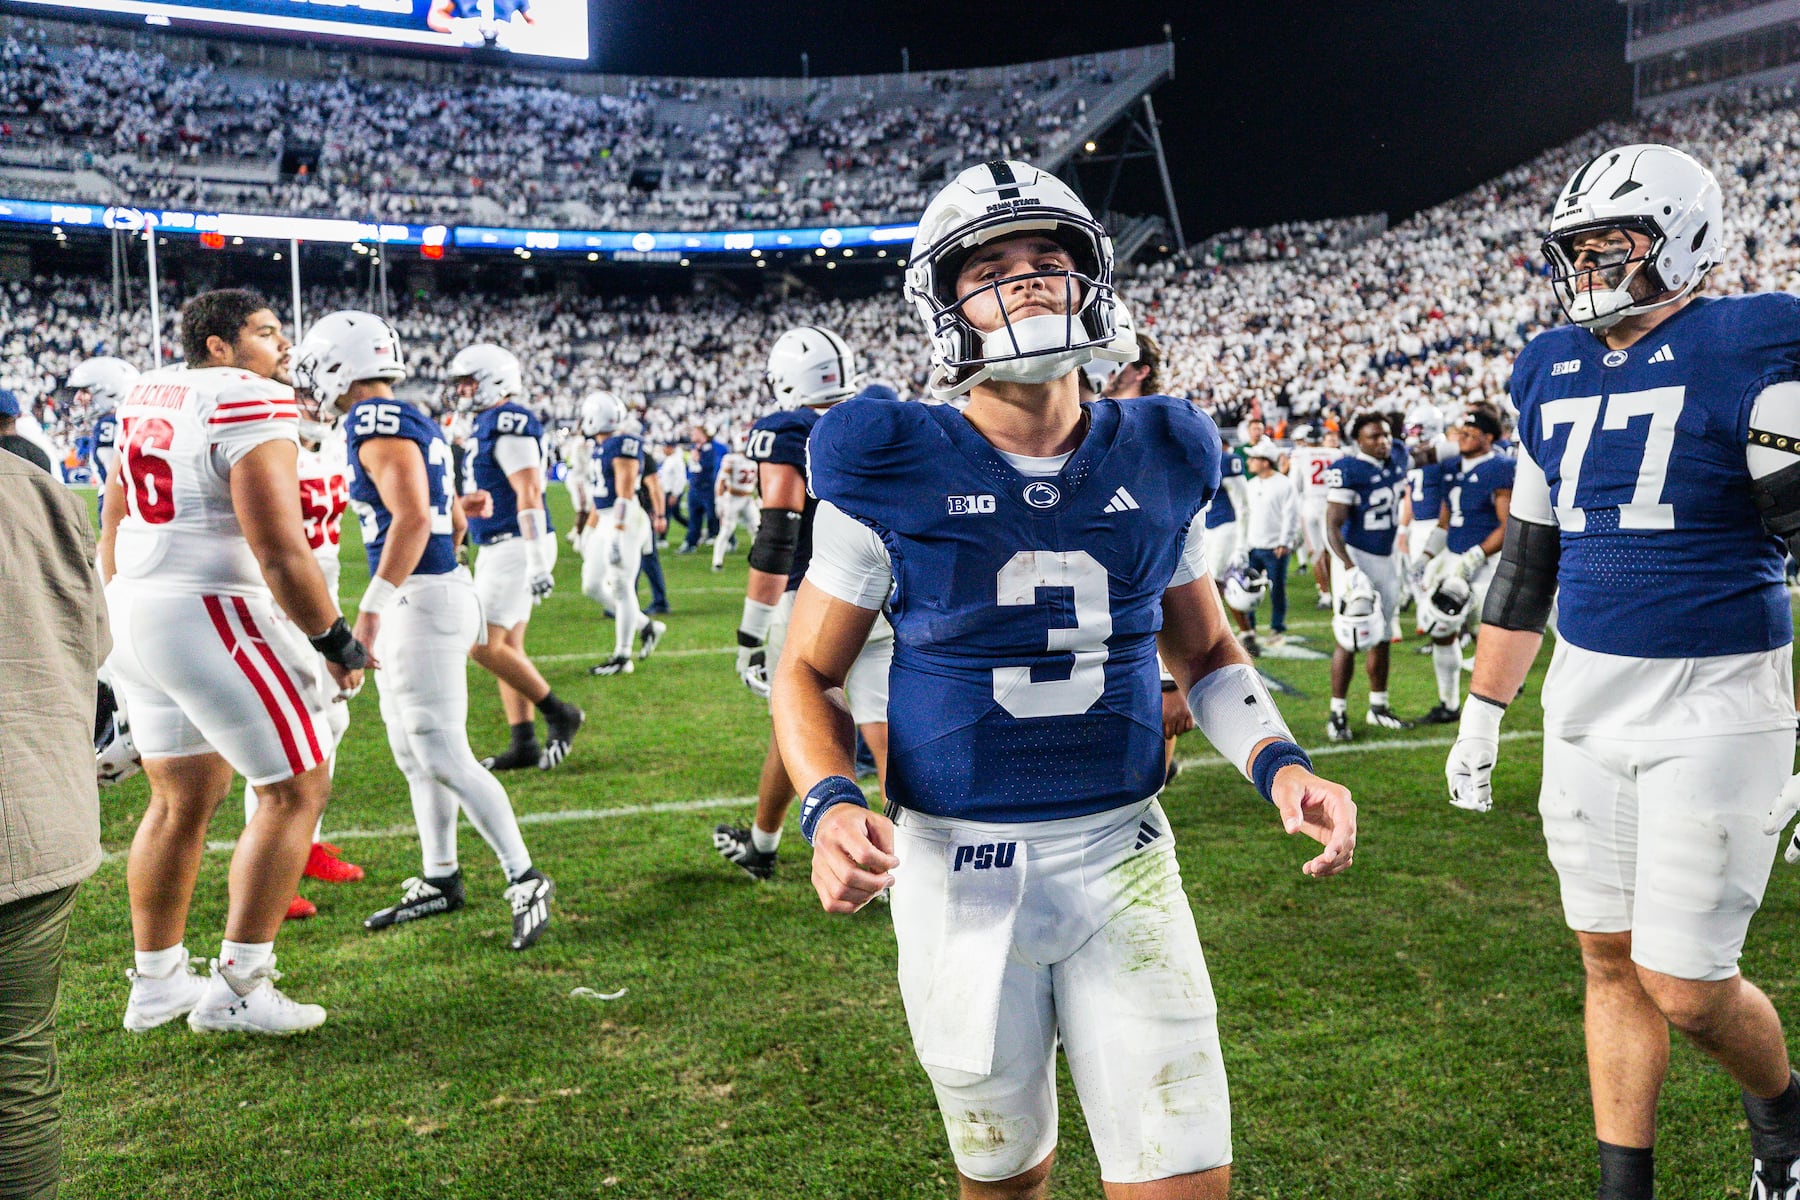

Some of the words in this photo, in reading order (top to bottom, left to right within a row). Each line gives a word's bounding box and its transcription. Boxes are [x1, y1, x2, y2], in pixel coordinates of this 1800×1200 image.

[986, 201, 1012, 213] PENN
[1012, 198, 1041, 206] STATE
[354, 404, 401, 436] 35
[497, 411, 528, 434] 67
[119, 416, 175, 525] 6
[1311, 459, 1332, 485] 2
[1540, 385, 1686, 532] 77
[992, 550, 1113, 719] 3
[954, 841, 1017, 872] PSU
